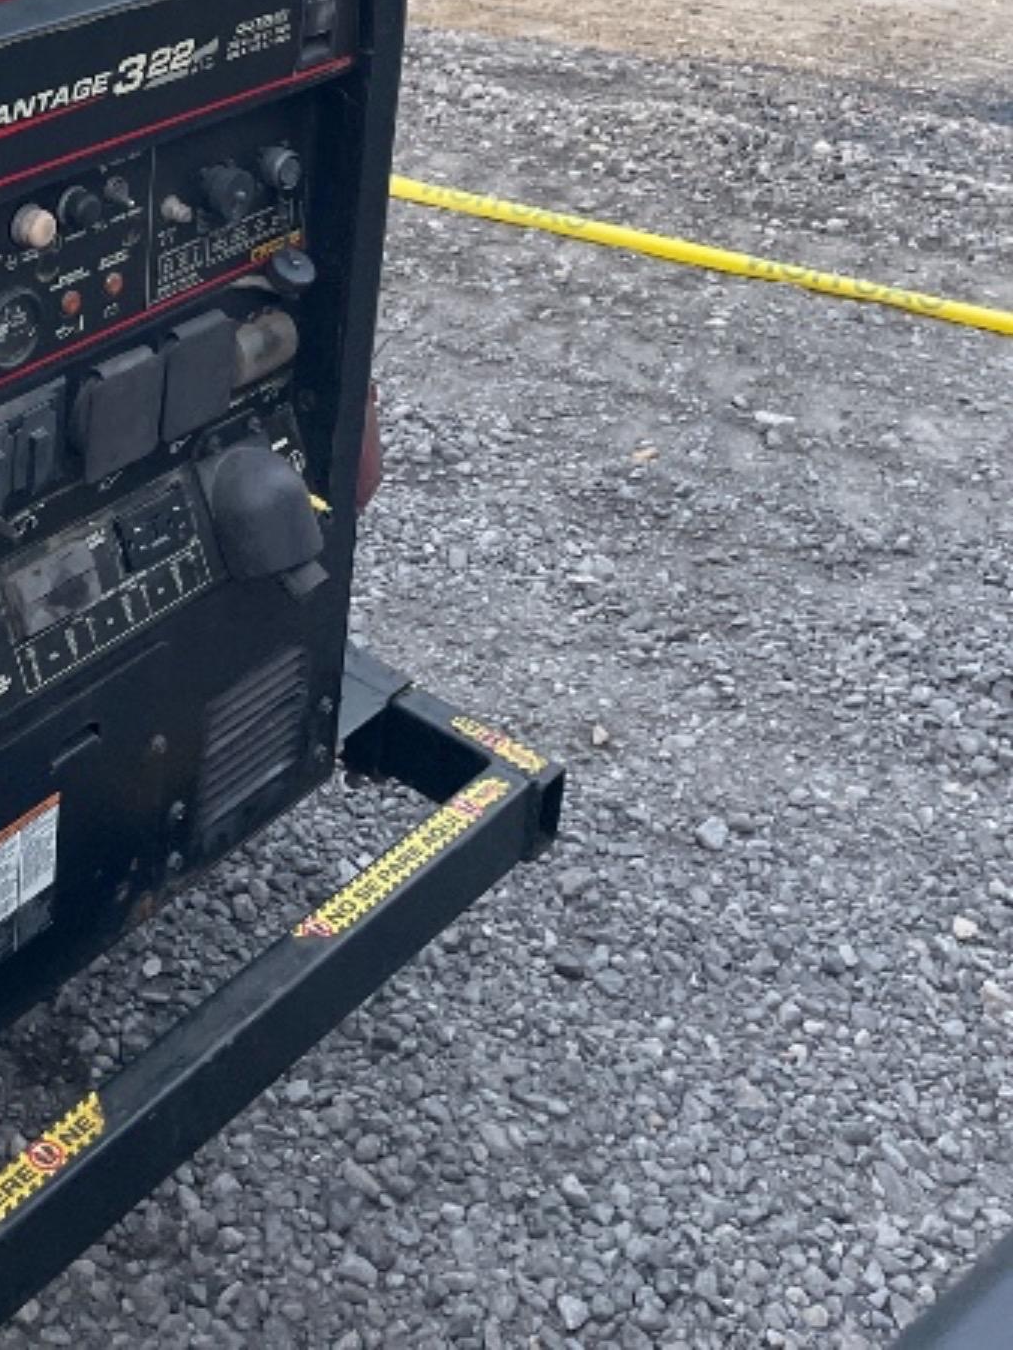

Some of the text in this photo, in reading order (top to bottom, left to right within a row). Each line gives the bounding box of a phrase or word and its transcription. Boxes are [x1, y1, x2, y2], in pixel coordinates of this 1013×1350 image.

[327, 900, 357, 924] NO
[355, 881, 379, 901] SE
[58, 1116, 94, 1147] NE
